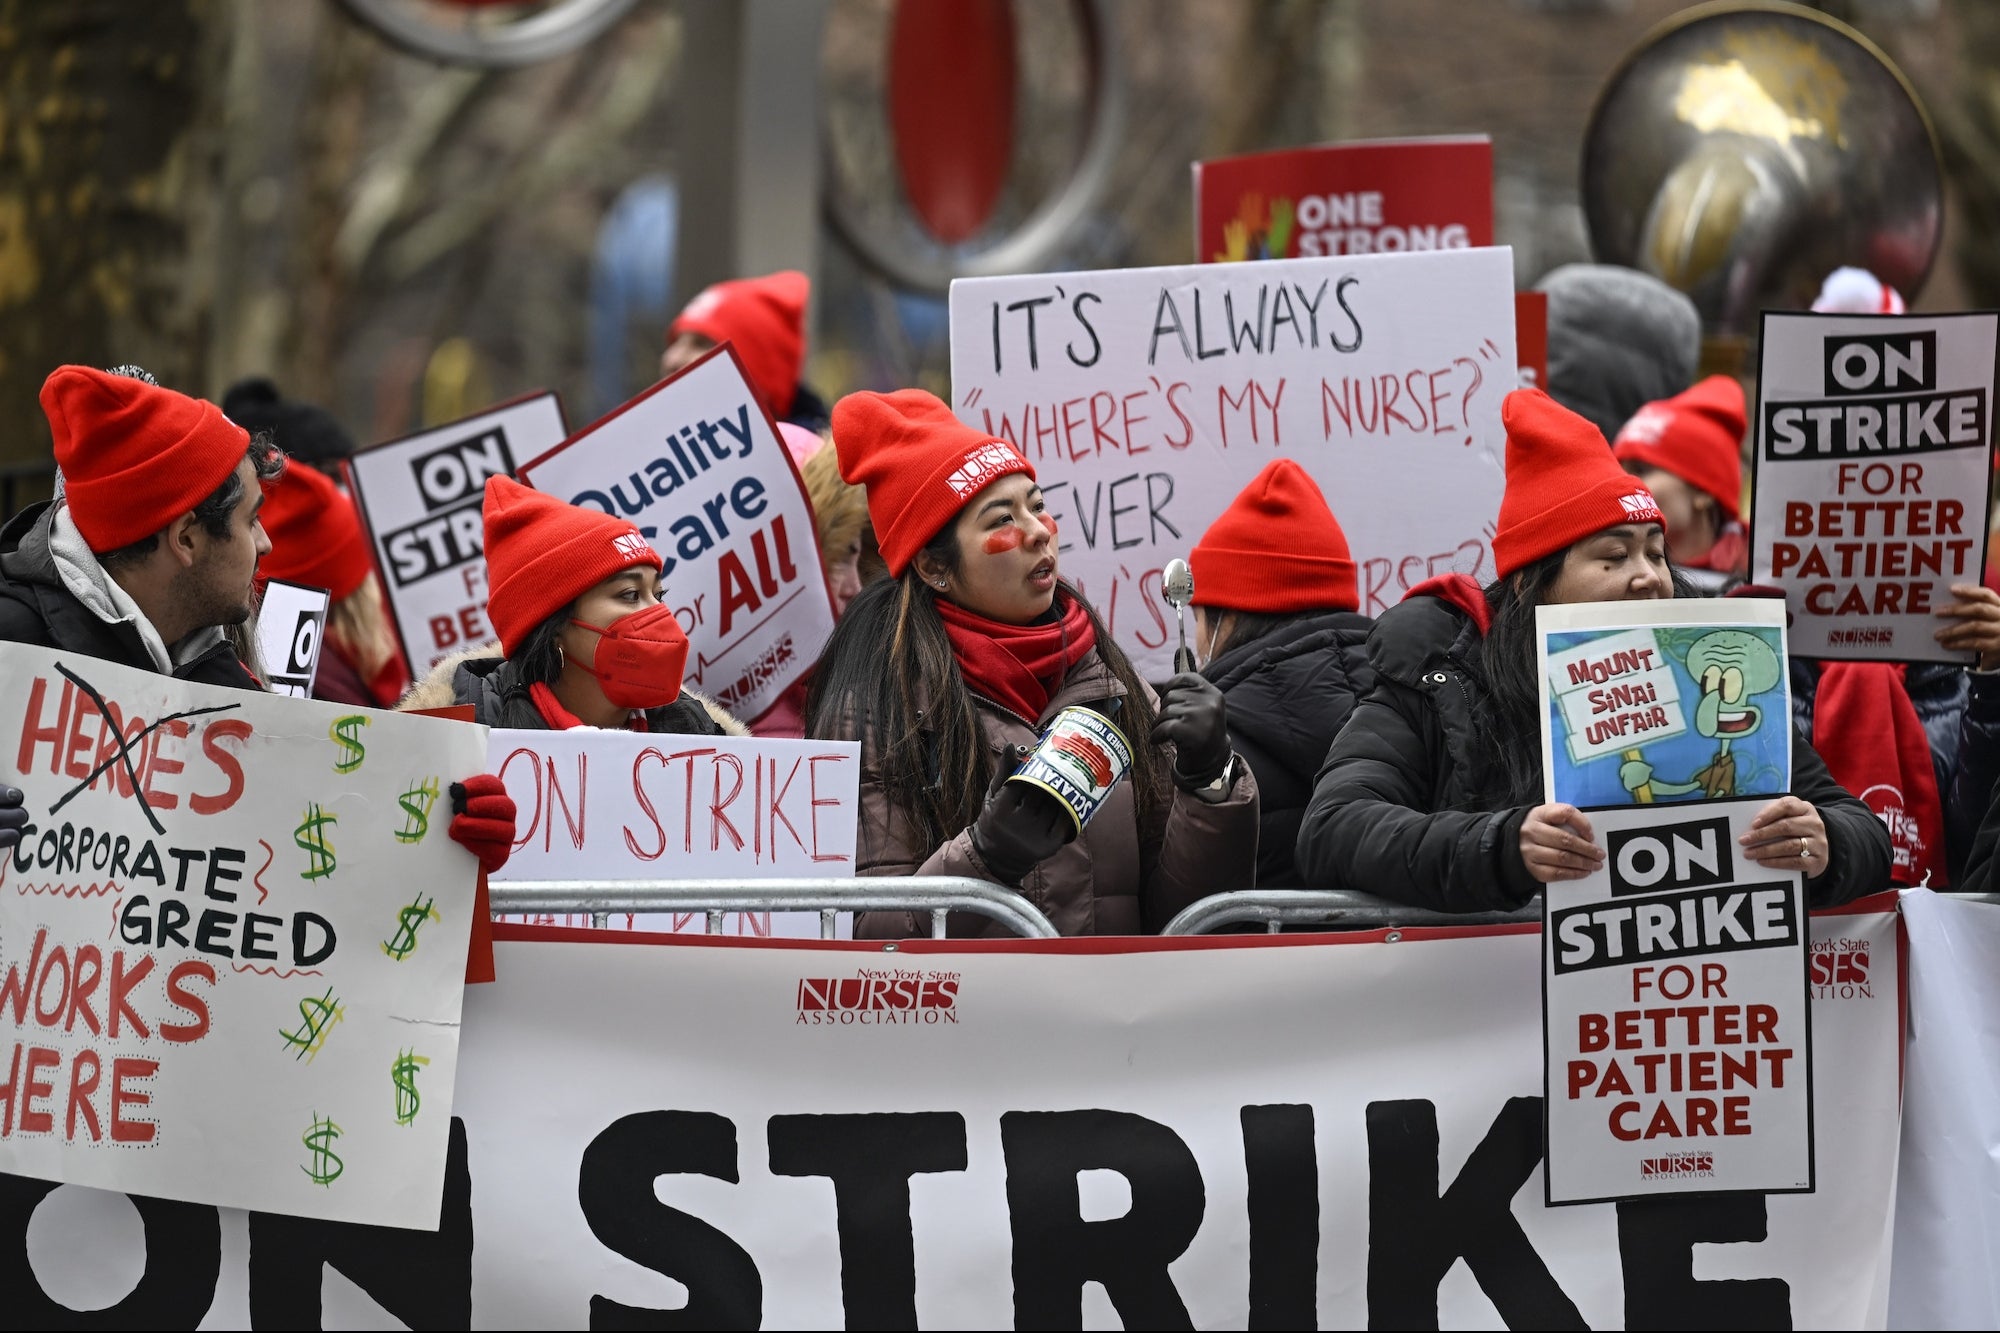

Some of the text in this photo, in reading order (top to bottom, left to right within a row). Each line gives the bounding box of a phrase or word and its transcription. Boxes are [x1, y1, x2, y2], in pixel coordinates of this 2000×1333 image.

[1297, 192, 1384, 229] ONE
[1299, 223, 1471, 258] STRONG
[992, 278, 1363, 374] IT'S ALWAYS
[1831, 340, 1924, 390] ON
[1218, 377, 1287, 449] MY
[1772, 396, 1979, 455] STRIKE
[422, 435, 506, 502] ON
[1838, 463, 1924, 495] FOR
[1040, 472, 1183, 551] EVER
[1785, 500, 1964, 538] BETTER
[389, 507, 485, 580] STR
[1771, 540, 1973, 579] PATIENT
[674, 513, 797, 638] or All
[1805, 582, 1934, 616] CARE
[1566, 648, 1655, 686] MOUNT
[1106, 732, 1131, 768] CRUSHED
[499, 746, 851, 866] ON STRIKE
[13, 821, 246, 903] CORPORATE
[1617, 828, 1720, 887] ON
[120, 895, 338, 967] GREED
[1558, 890, 1790, 965] STRIKE
[1839, 937, 1870, 952] State
[0, 928, 217, 1043] WORKS
[797, 978, 961, 1011] NURSES
[857, 968, 961, 981] New York State
[1633, 963, 1728, 1002] FOR
[796, 1010, 957, 1025] ASSOCIATION
[1579, 1004, 1779, 1053] BETTER
[1567, 1049, 1793, 1100] PATIENT
[1608, 1096, 1752, 1141] CARE
[1641, 1157, 1713, 1175] NURSES
[1641, 1170, 1714, 1181] ASSOCIATION
[1665, 1151, 1681, 1159] New
[1682, 1150, 1696, 1158] York
[579, 1096, 1792, 1331] STRIKE
